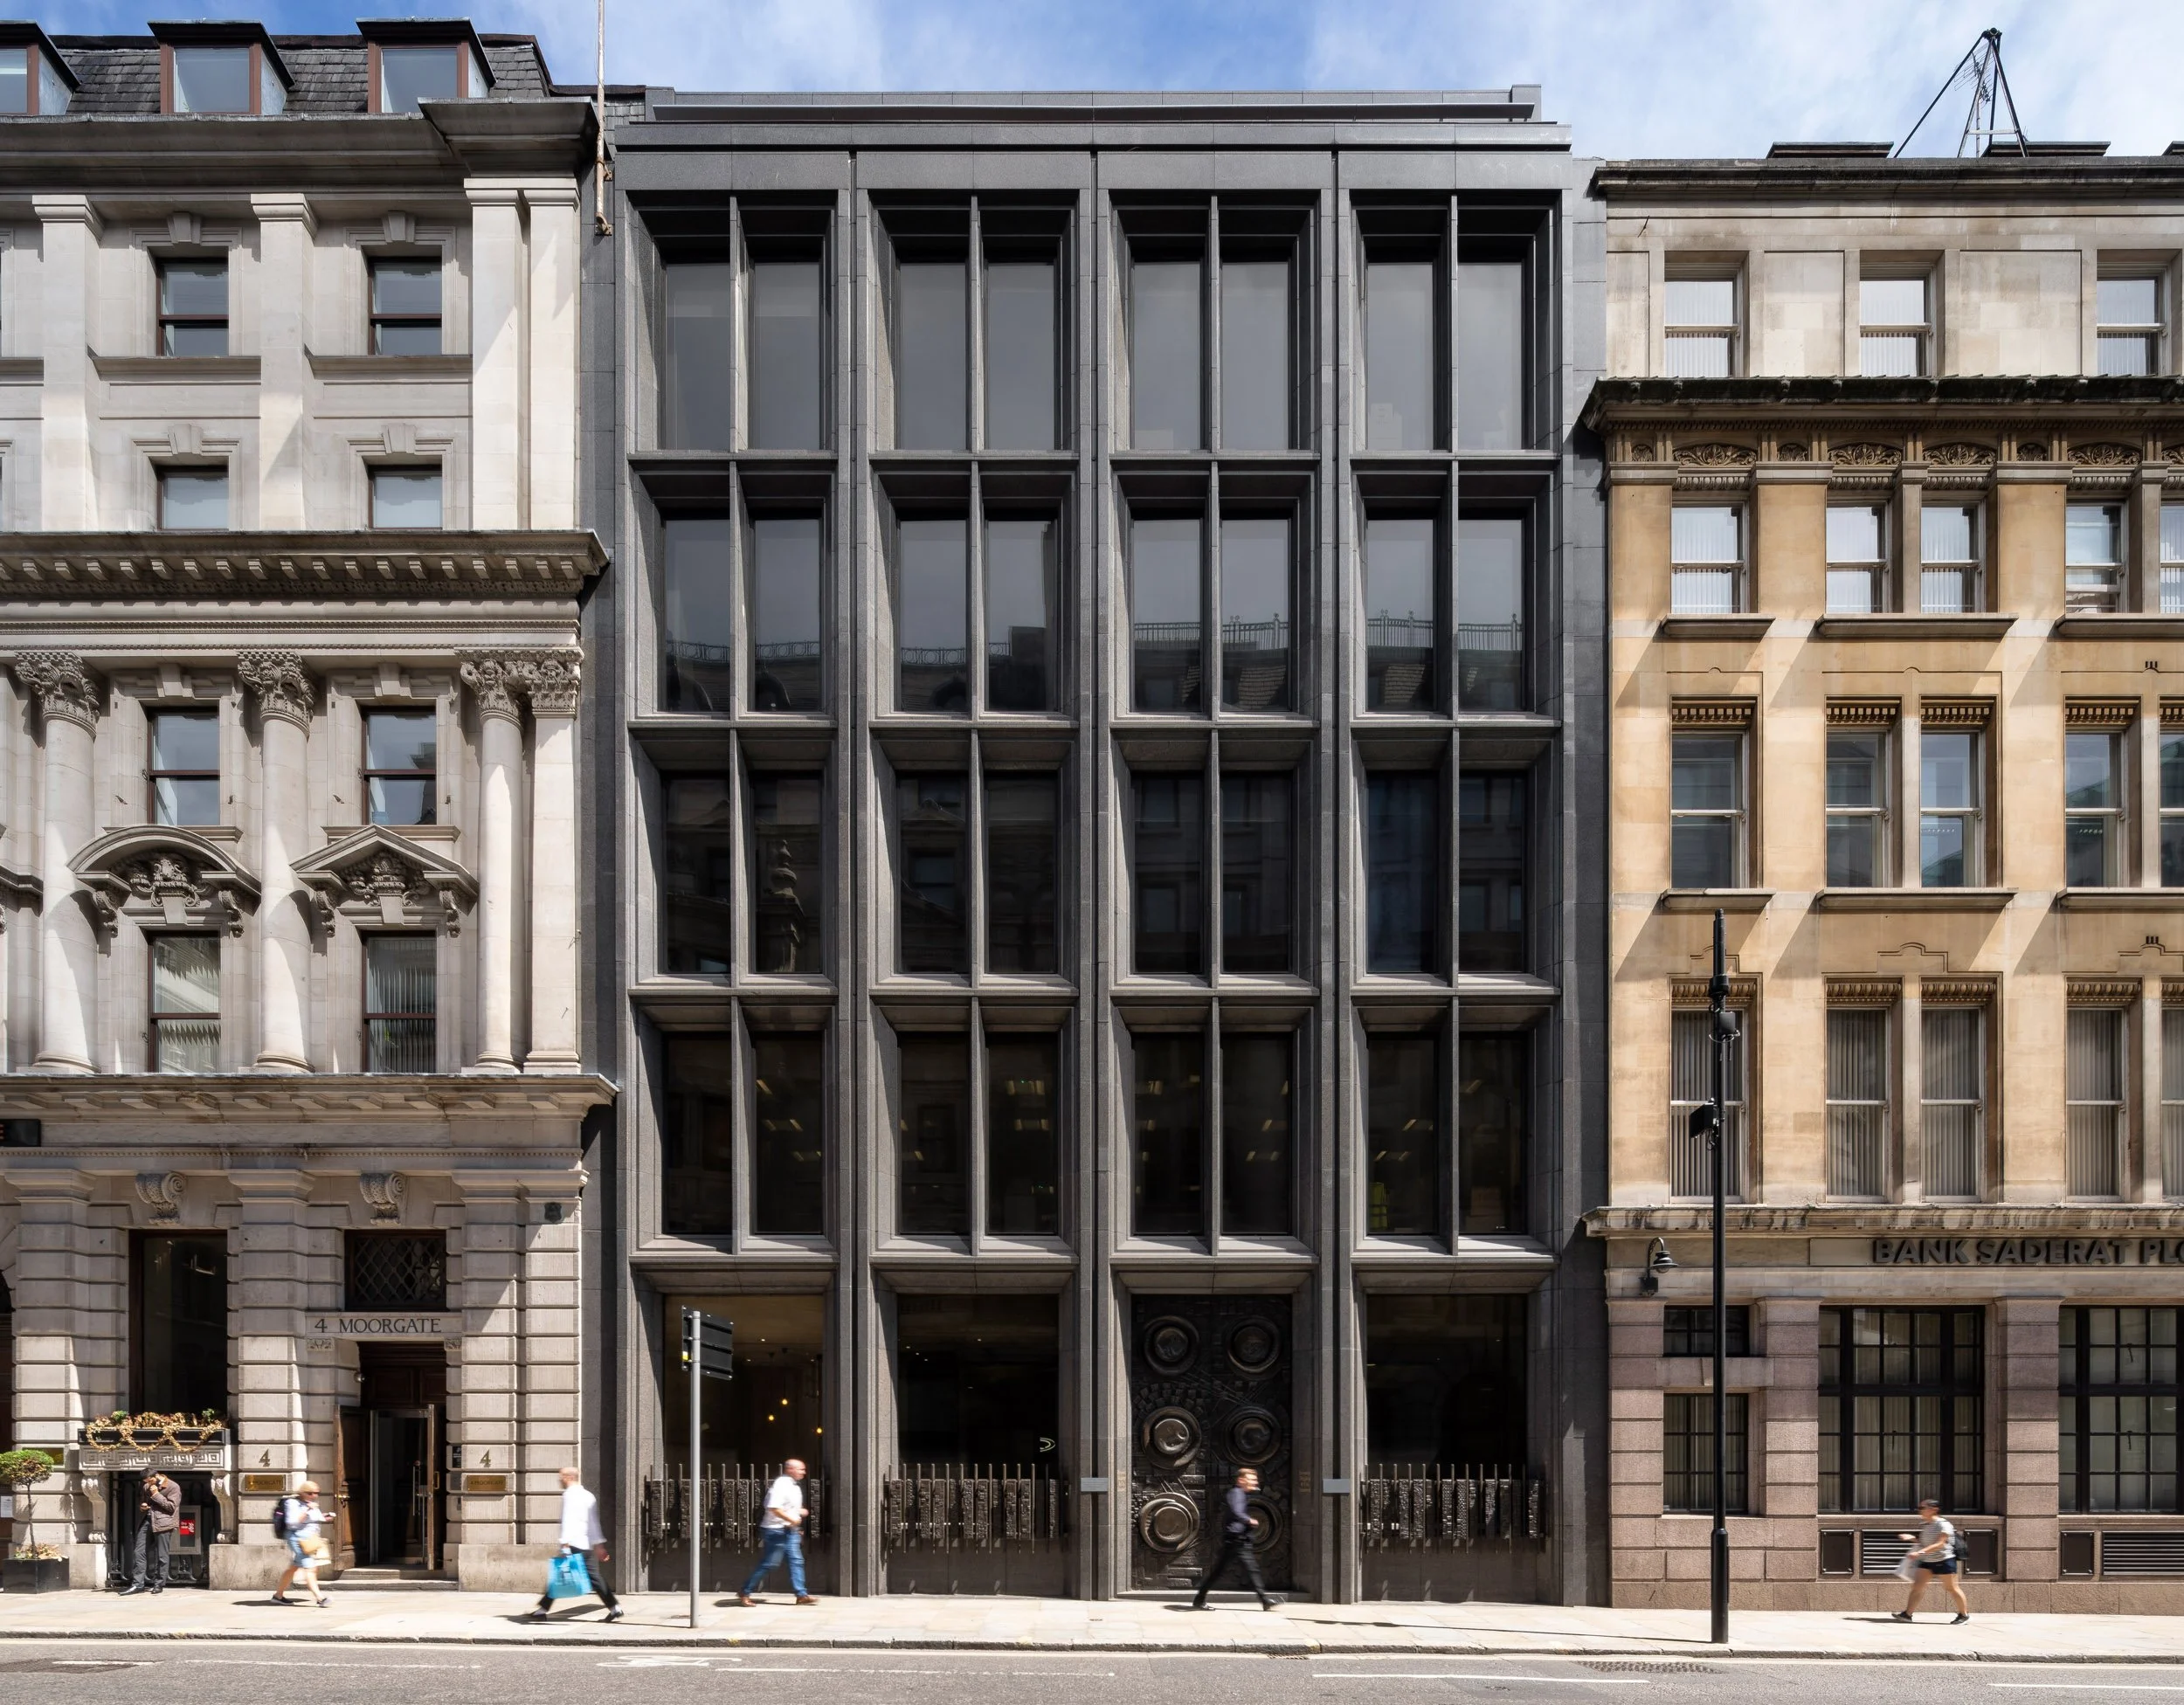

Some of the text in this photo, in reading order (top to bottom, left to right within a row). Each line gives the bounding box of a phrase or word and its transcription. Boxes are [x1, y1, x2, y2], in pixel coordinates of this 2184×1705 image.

[1873, 1239, 1970, 1264] BANK
[1976, 1239, 2132, 1264] SADERAT
[314, 1318, 442, 1333] 4 MOORGATE
[259, 1448, 271, 1467] 4
[479, 1449, 492, 1467] 4
